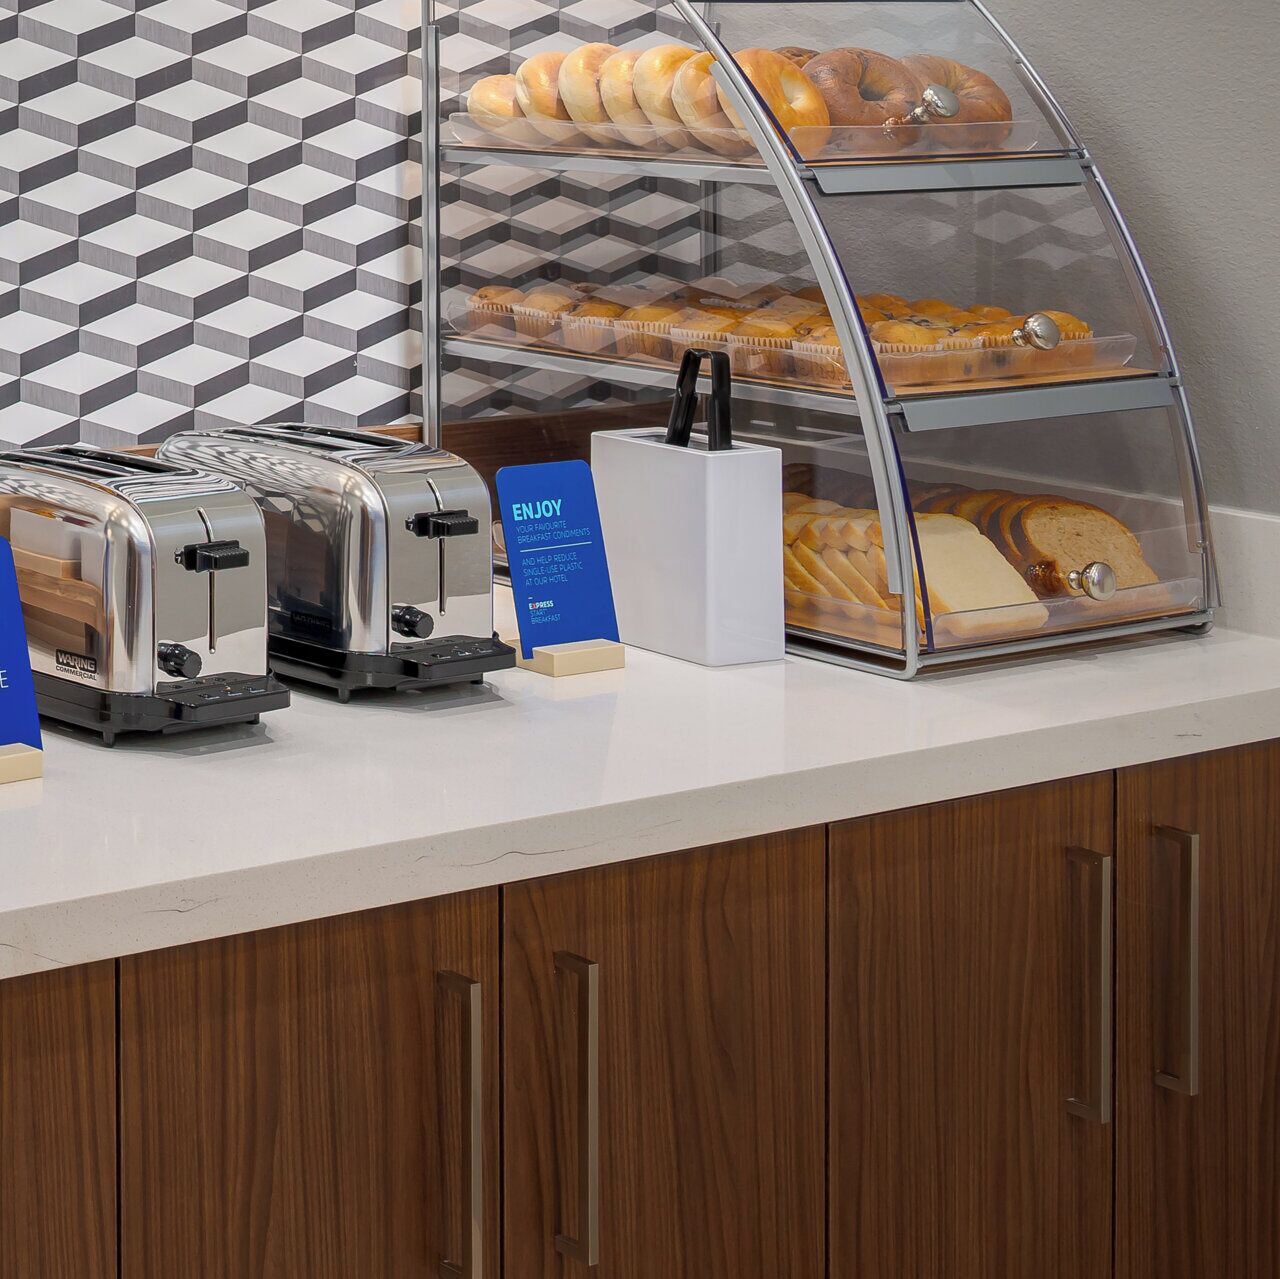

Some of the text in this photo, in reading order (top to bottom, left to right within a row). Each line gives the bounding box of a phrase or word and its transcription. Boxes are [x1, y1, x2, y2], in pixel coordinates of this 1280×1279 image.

[512, 499, 561, 521] ENJOY
[516, 520, 567, 534] YOUR FAVOURITE
[517, 527, 591, 544] BREAKFAST CONDIMENTS
[522, 552, 577, 566] AND HELP REDUCE
[559, 561, 584, 572] PLASTIC
[525, 573, 568, 587] AT OUR HOTEL
[528, 600, 554, 610] EXPRESS
[57, 651, 96, 671] WARING
[55, 665, 97, 682] COMMERCIAL
